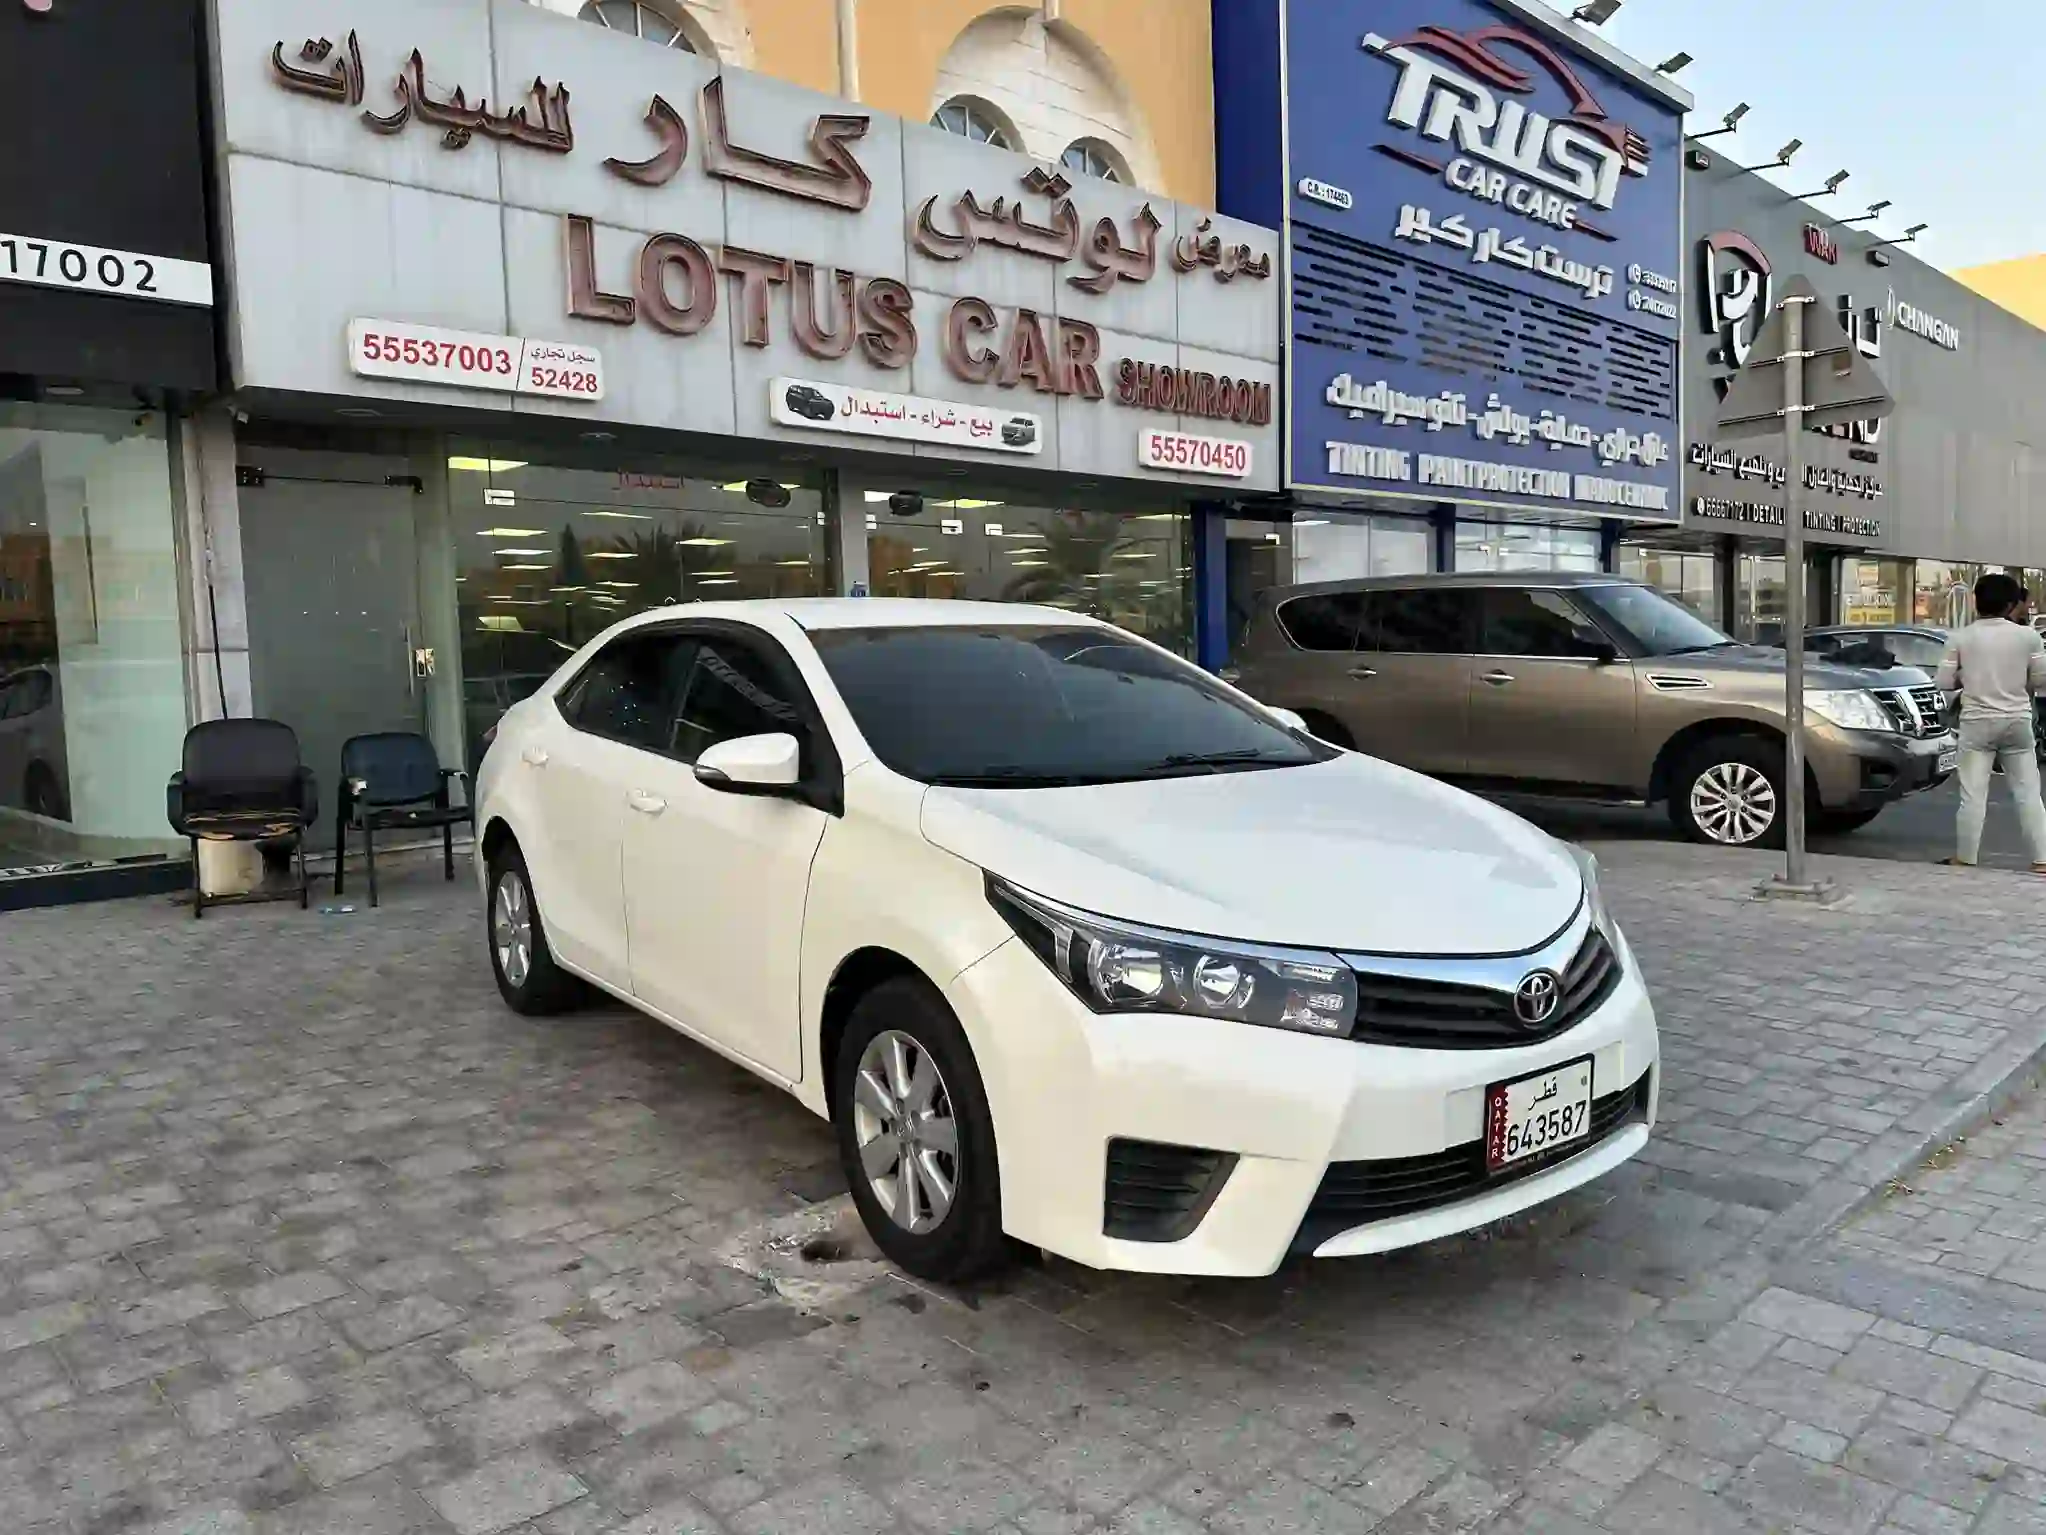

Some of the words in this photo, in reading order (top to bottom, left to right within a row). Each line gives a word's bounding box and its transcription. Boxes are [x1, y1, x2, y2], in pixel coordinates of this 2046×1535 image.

[272, 28, 573, 153] للسيارات
[601, 75, 872, 211] كار
[1361, 31, 1648, 210] TRUST
[1445, 158, 1507, 204] CAR
[1503, 183, 1578, 230] CARE
[915, 166, 1163, 293] لوتس
[1172, 217, 1270, 284] معرض
[563, 213, 918, 368] LOTUS
[946, 296, 1104, 400] CAR
[1114, 357, 1272, 426] SHOWROOM
[1898, 302, 1960, 352] CHANGAN
[363, 333, 512, 374] 55537003
[531, 346, 566, 360] تجاري
[568, 351, 595, 364] سجل
[531, 367, 598, 393] 52428
[841, 396, 906, 425] استبدال
[921, 407, 956, 430] شراء
[970, 410, 993, 437] بيع
[1151, 434, 1246, 472] 55570450
[1326, 441, 1411, 481] TINTING
[1528, 1076, 1558, 1111] قطر
[1491, 1096, 1502, 1158] QATAR
[1507, 1100, 1587, 1156] 643587
